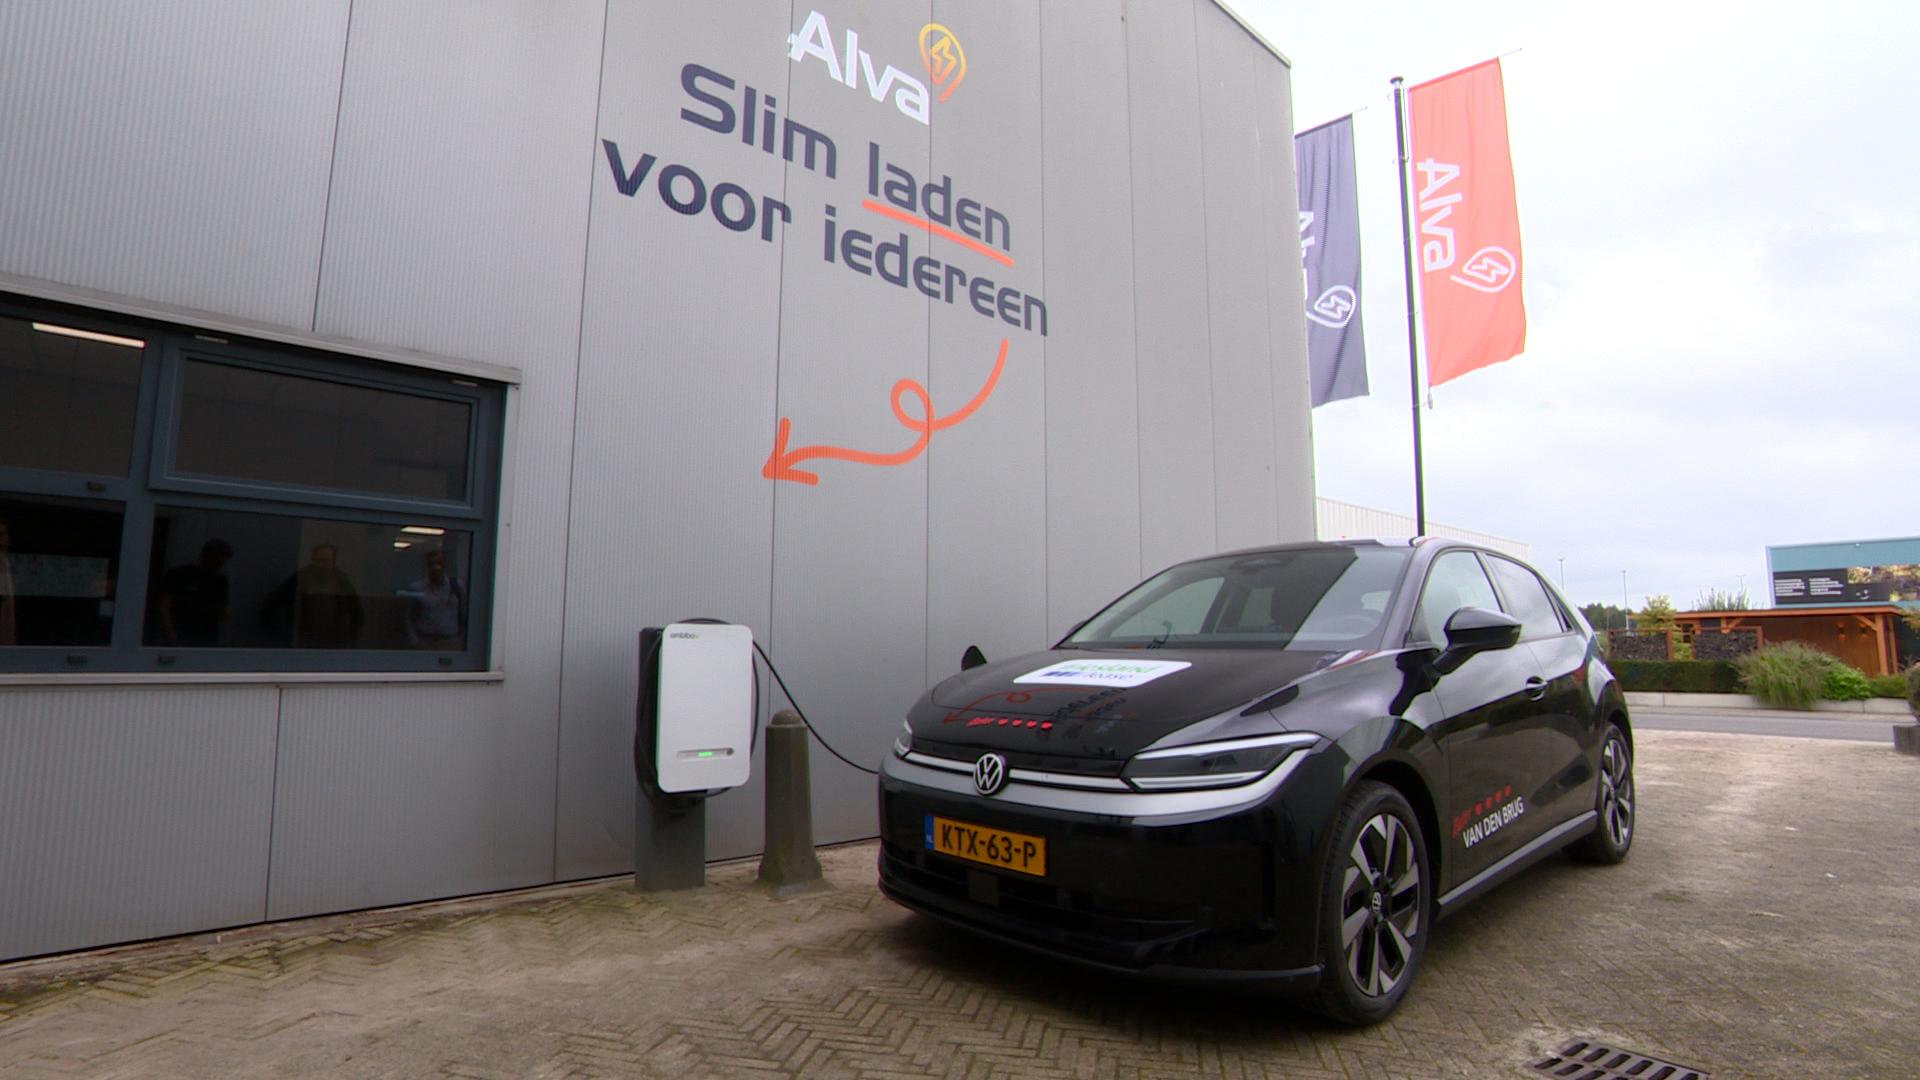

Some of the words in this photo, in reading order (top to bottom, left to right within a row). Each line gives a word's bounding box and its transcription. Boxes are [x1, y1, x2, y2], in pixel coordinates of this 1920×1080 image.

[787, 10, 930, 125] Alva
[680, 62, 837, 179] Slim
[868, 141, 1011, 252] laden
[601, 138, 793, 243] voor
[823, 204, 1048, 337] iedereen
[1417, 158, 1463, 273] Alva
[942, 823, 1037, 868] KTX-63-P
[1462, 821, 1483, 849] VAN
[1483, 810, 1503, 837] DEN
[1502, 796, 1524, 824] BRUG
